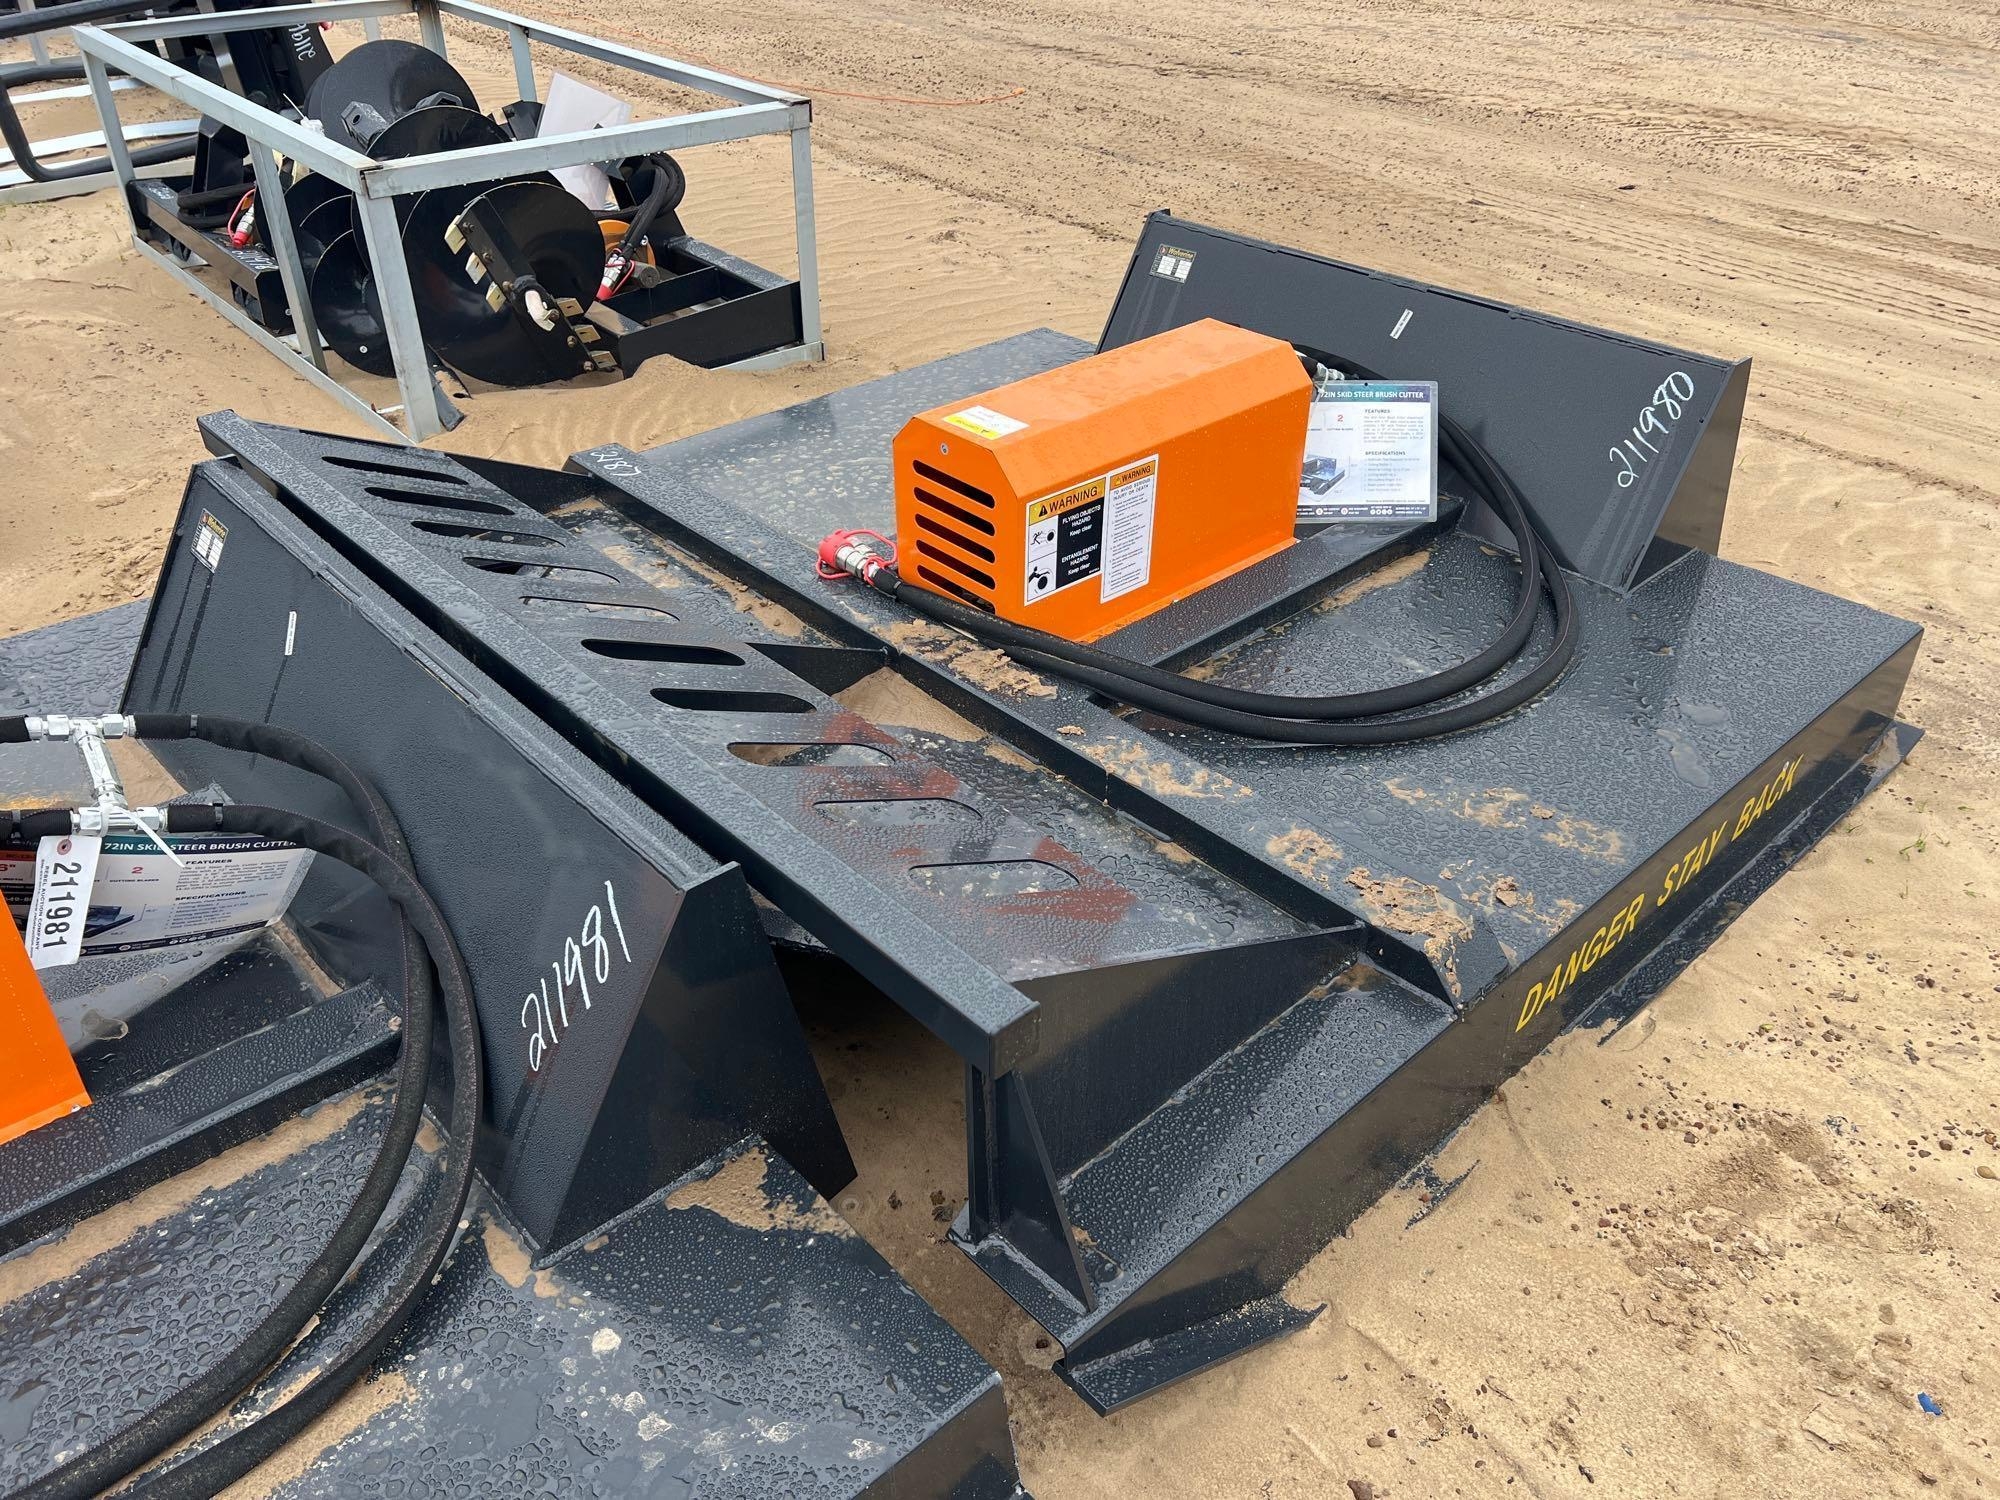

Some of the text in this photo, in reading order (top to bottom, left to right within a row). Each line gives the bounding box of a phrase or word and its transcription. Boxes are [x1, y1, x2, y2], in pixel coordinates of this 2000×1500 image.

[1398, 391, 1424, 399] CUTTER
[1337, 414, 1344, 422] 2
[1609, 371, 1694, 488] 211980
[1122, 465, 1151, 482] WARNING
[1049, 486, 1098, 512] WARNING
[1062, 504, 1102, 524] FLYING OBJECTS
[1071, 516, 1092, 527] HAZARD
[1070, 524, 1092, 536] Keep clear
[1062, 544, 1098, 563] ENTANGLEMENT
[1070, 554, 1090, 566] HAZARD
[1068, 566, 1080, 576] Keep
[1080, 562, 1091, 571] clear
[104, 842, 134, 850] 72IN
[176, 890, 246, 900] SPECIFICATIONS
[1515, 753, 1804, 1032] DANGER STAY BACK
[42, 862, 82, 948] 211981
[35, 918, 43, 950] COMPANY
[522, 880, 632, 1072] 211981
